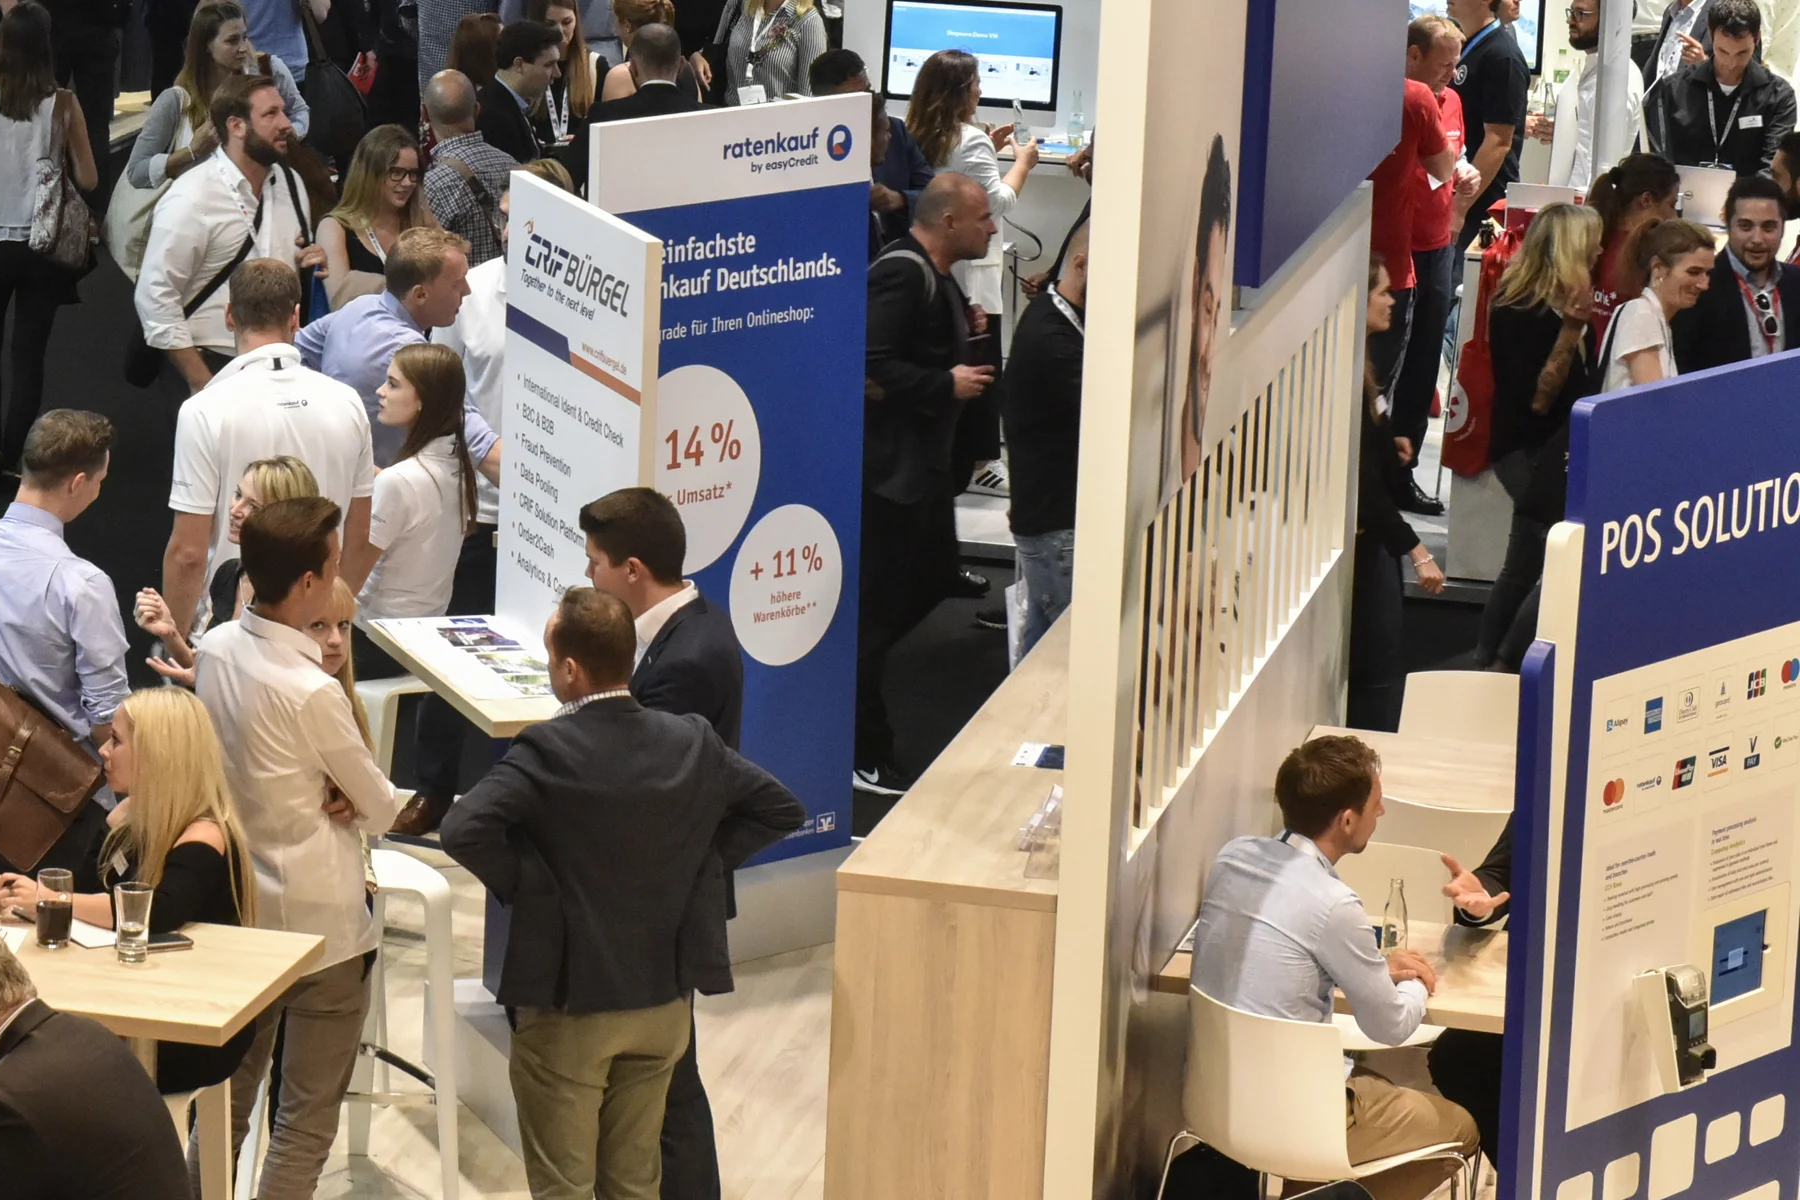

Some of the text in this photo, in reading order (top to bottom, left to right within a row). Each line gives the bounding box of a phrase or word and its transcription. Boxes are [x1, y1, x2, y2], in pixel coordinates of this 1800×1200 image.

[723, 126, 819, 160] ratenkauf
[751, 154, 819, 174] by easyCredit
[717, 252, 841, 292] Deutschlands.
[521, 268, 596, 322] Together to the next level
[691, 305, 815, 336] für Ihren Onlineshop:
[522, 403, 535, 424] B2C
[541, 415, 555, 436] B2B
[523, 373, 560, 409] International
[561, 396, 577, 420] Ident
[583, 410, 603, 436] Credit
[603, 423, 624, 448] Check
[521, 433, 572, 478] Fraud Prevention
[665, 418, 742, 471] 14 %
[520, 462, 559, 503] Data Pooling
[519, 492, 534, 514] CRIF
[534, 502, 559, 532] Solution
[518, 522, 555, 560] Order2Cash
[1601, 507, 1662, 575] POS
[516, 551, 546, 584] Analytics
[770, 590, 802, 605] höhere
[1748, 677, 1766, 692] JCB
[1711, 754, 1728, 769] VISA
